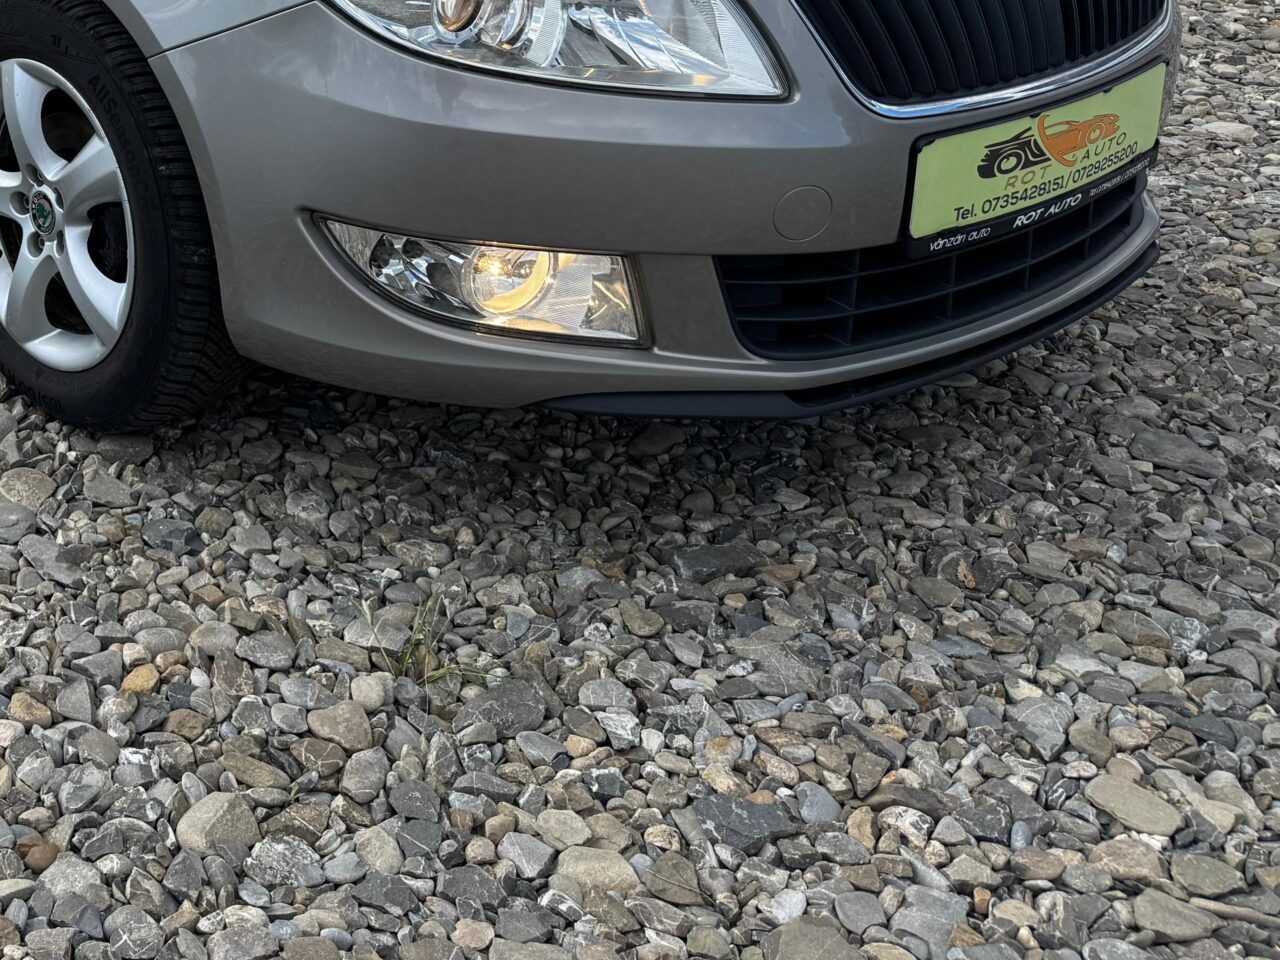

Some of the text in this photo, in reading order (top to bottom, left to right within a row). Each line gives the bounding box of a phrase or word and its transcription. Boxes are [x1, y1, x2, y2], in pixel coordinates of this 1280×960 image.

[1004, 132, 1127, 191] ROT AUTO
[954, 205, 977, 222] Tel.
[1013, 193, 1082, 229] ROT AUTO
